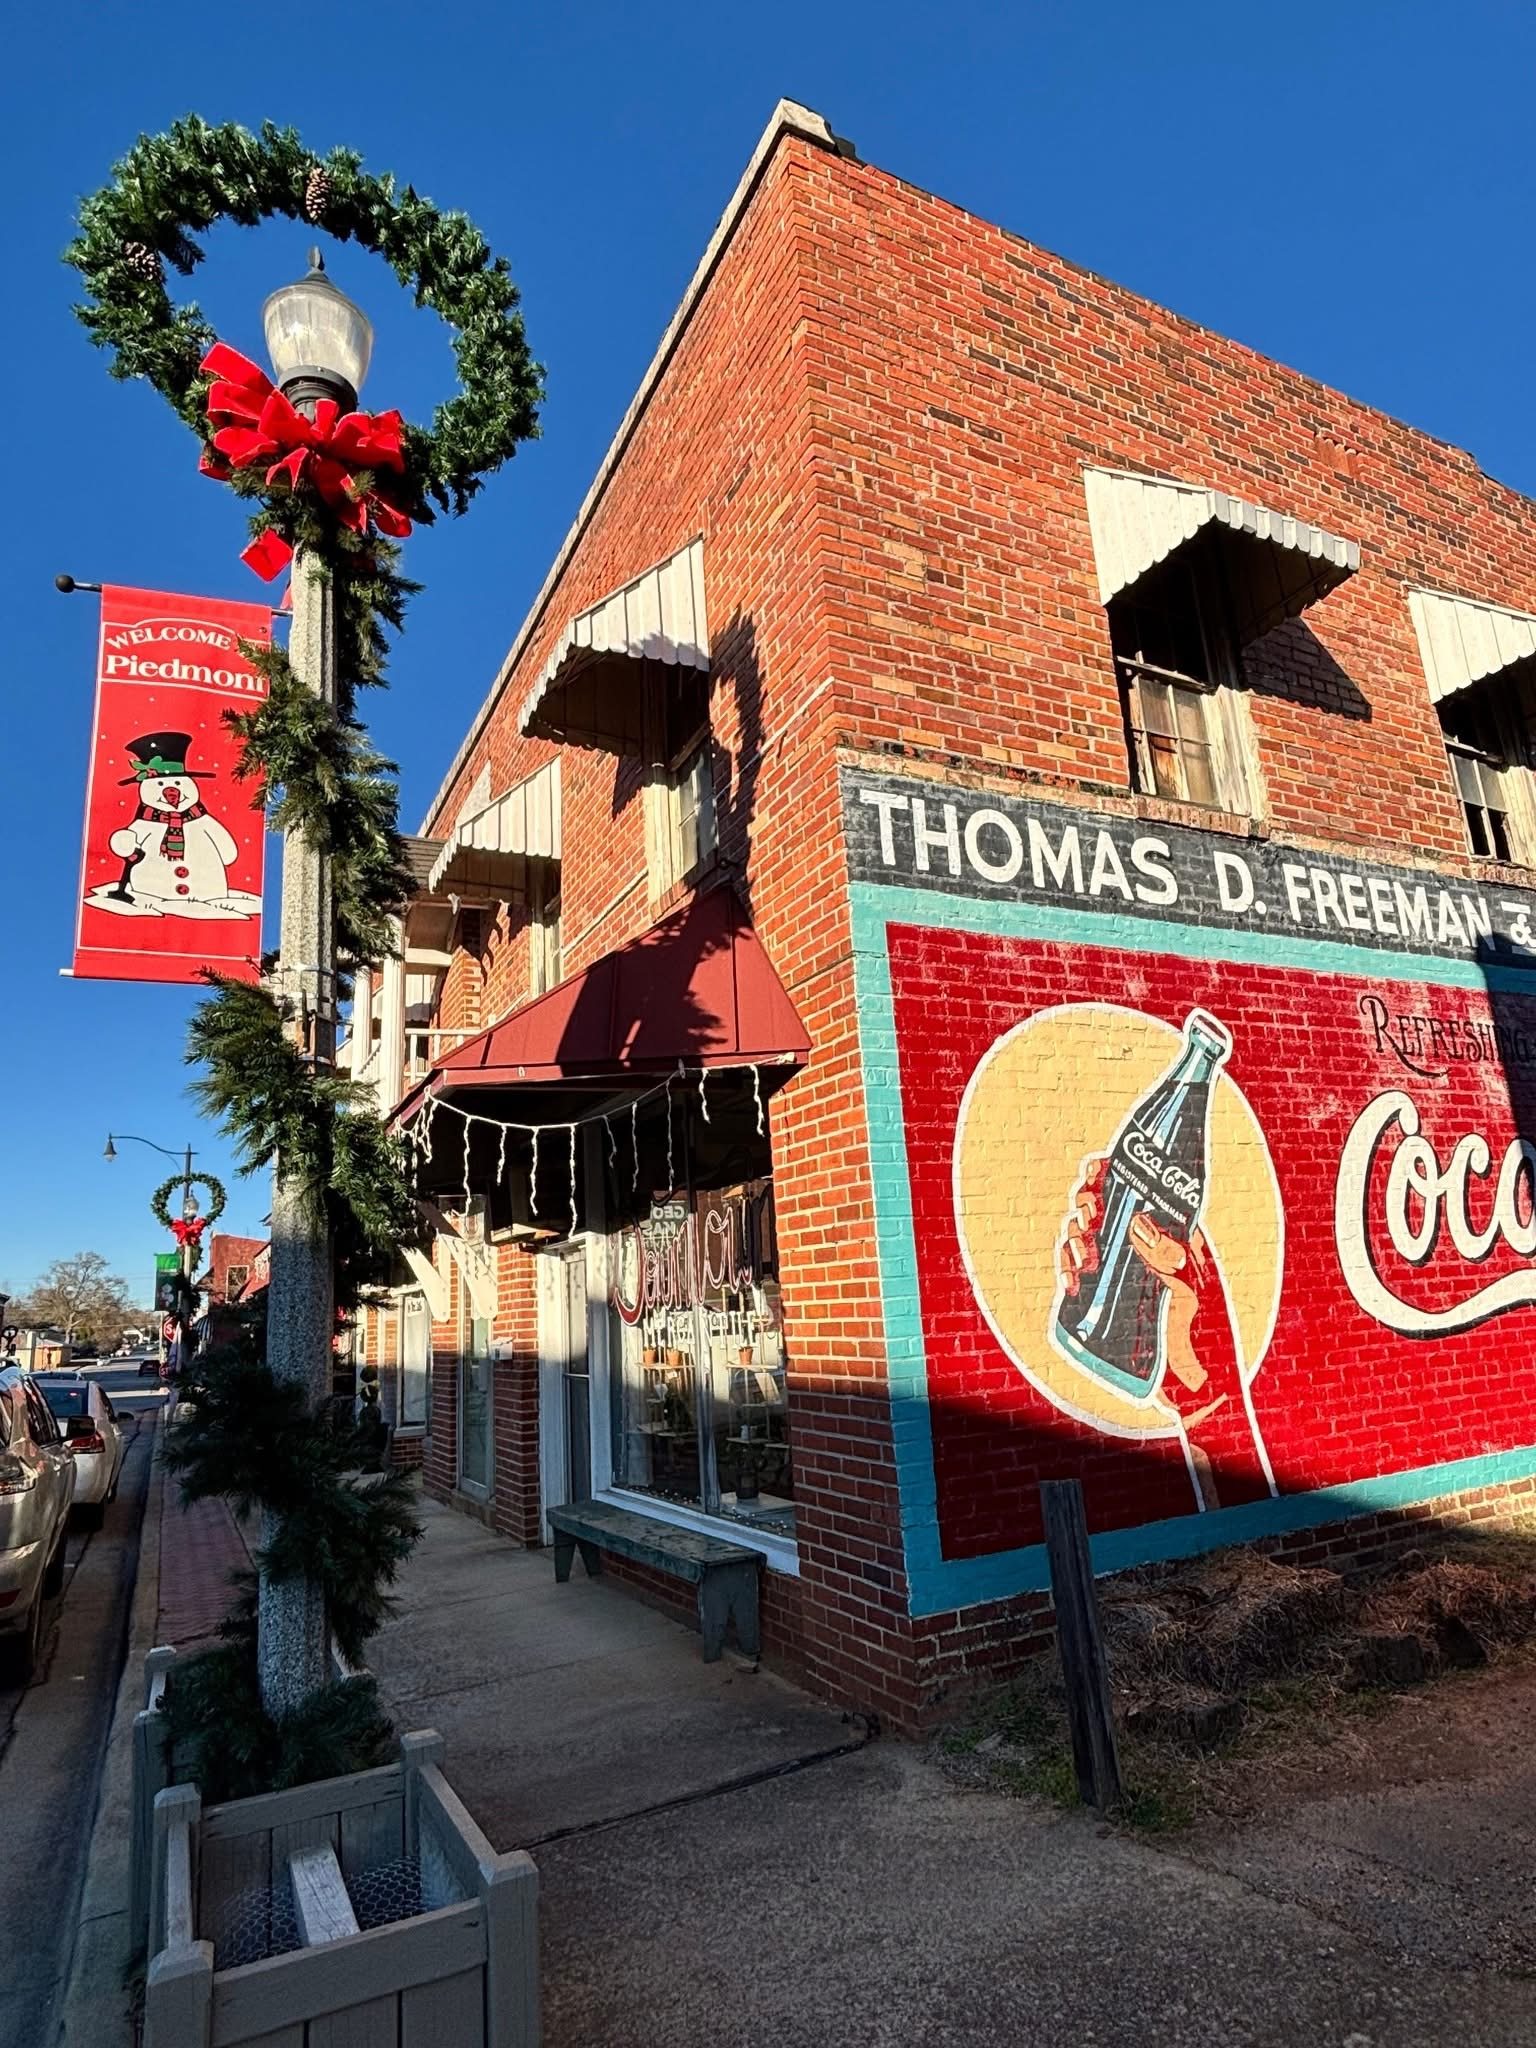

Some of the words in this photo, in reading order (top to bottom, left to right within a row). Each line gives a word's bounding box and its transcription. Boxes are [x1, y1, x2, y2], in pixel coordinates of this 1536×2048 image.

[106, 626, 232, 650] WELCOME
[106, 654, 265, 693] Piedmont
[859, 788, 1179, 905] THOMAS
[1213, 850, 1266, 915] D.
[1282, 863, 1496, 951] FREEMAN
[1113, 1158, 1148, 1194] REGISTERED
[1122, 1131, 1163, 1179] Coca
[1161, 1166, 1200, 1209] Cola
[1151, 1191, 1187, 1225] TRADEMARK
